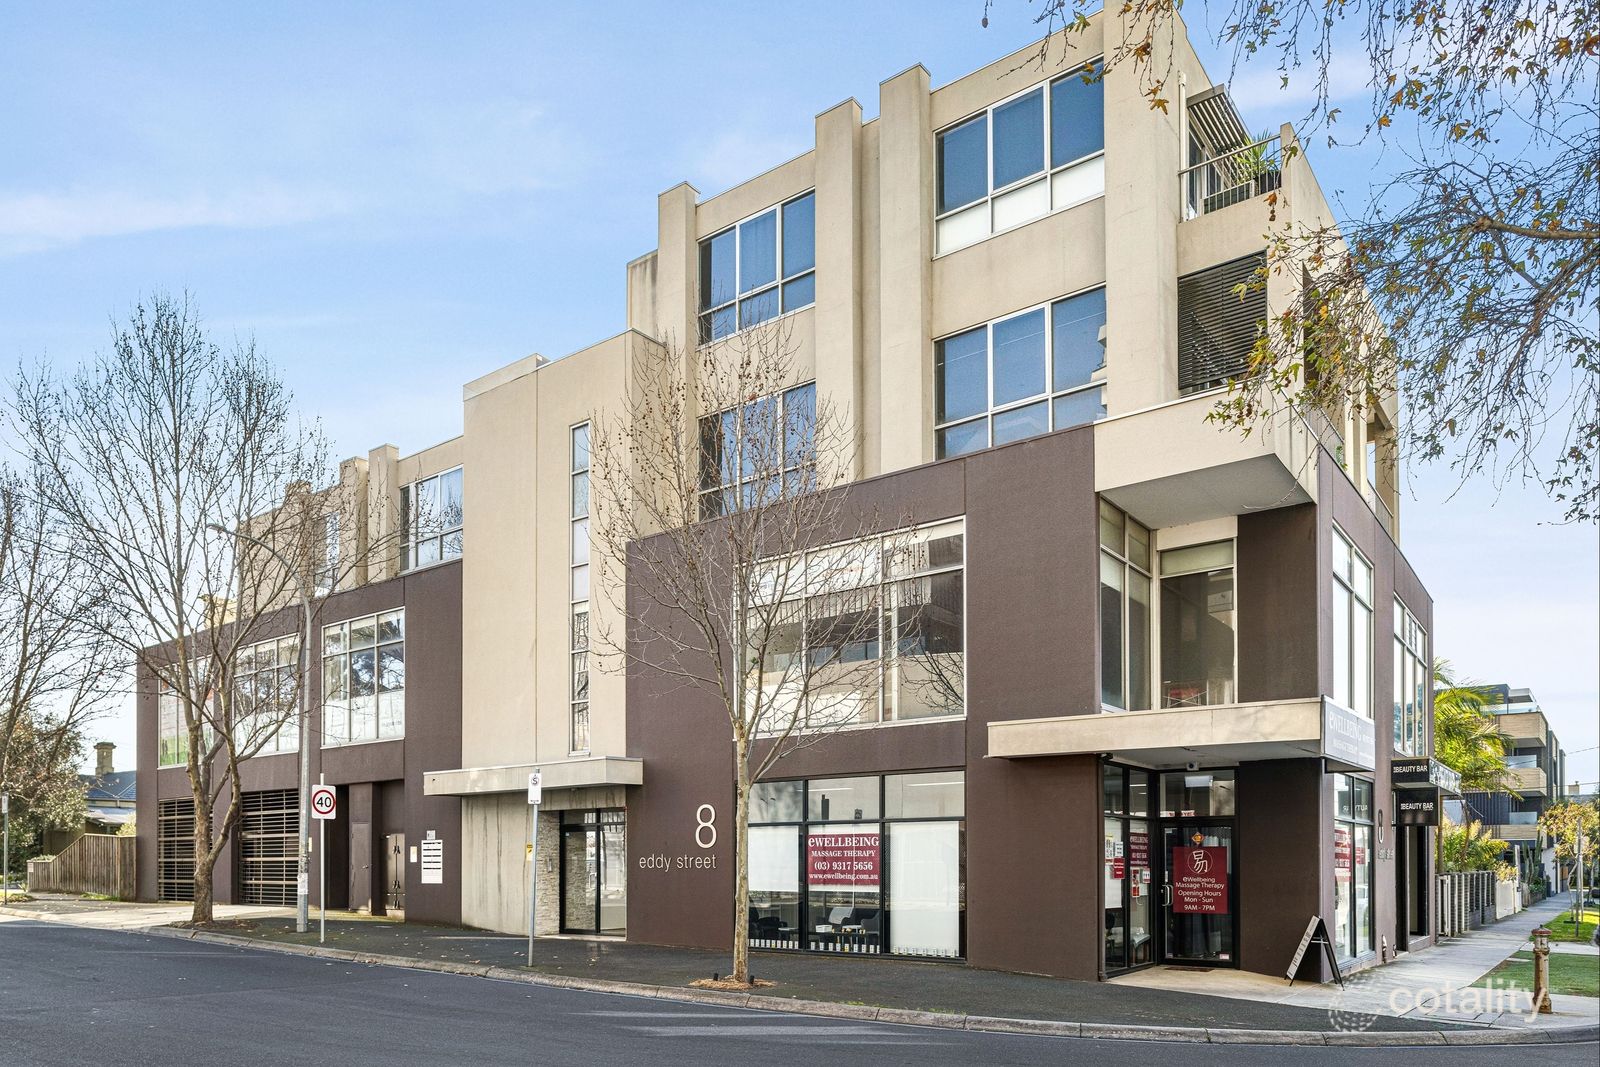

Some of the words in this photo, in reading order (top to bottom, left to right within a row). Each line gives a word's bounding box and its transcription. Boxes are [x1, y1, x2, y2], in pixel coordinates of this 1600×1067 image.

[316, 796, 332, 808] 40
[695, 804, 717, 849] 8
[808, 836, 880, 847] eWELLBEING
[639, 854, 672, 872] eddy
[676, 854, 716, 868] street
[814, 862, 830, 870] (03)
[832, 862, 851, 870] 9317
[854, 862, 872, 870] 5656
[1192, 850, 1208, 873] 易
